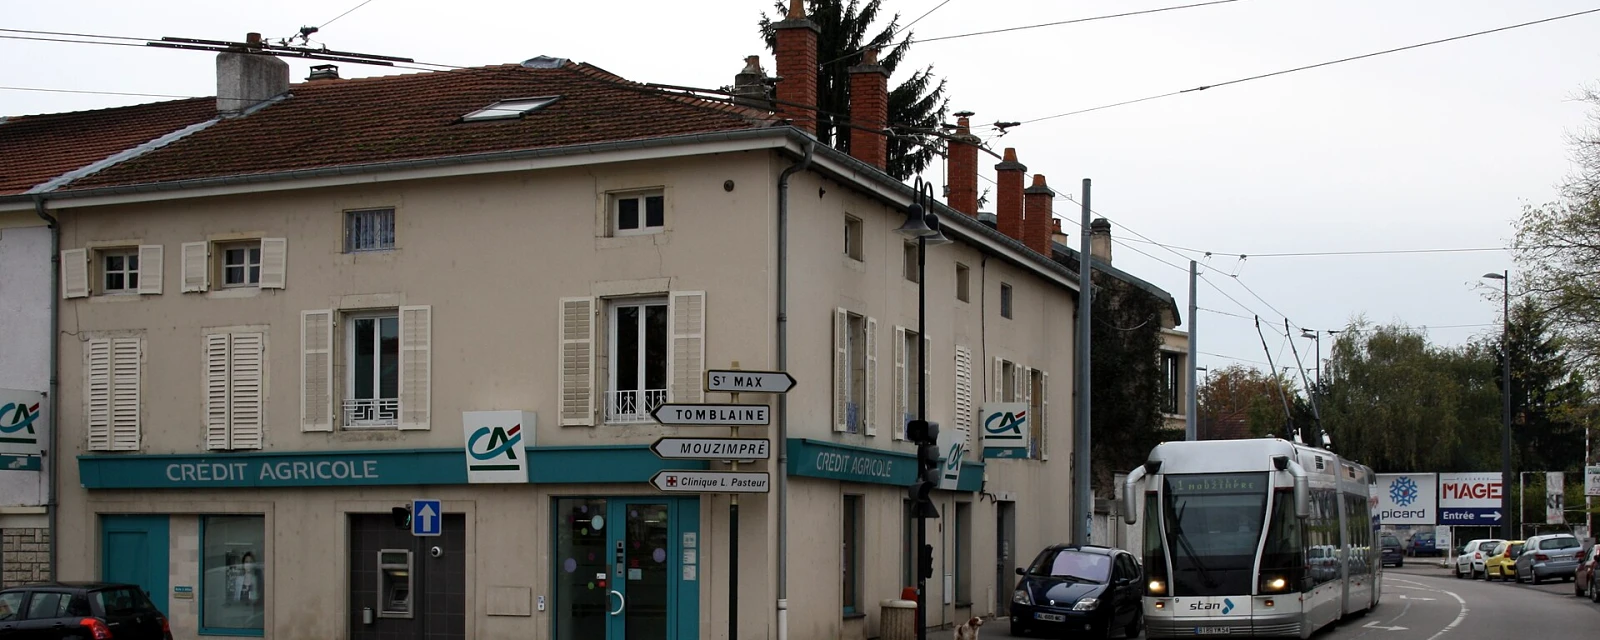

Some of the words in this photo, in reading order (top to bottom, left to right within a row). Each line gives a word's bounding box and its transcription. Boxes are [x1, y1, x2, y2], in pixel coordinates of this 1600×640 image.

[734, 376, 762, 388] MAX
[675, 409, 765, 421] TOMBLAINE
[680, 441, 766, 455] MOUZIMPRÉ
[816, 450, 850, 473] CRÉDIT
[850, 456, 893, 477] AGRICOLE
[166, 459, 248, 481] CRÉDIT
[259, 460, 379, 481] AGRICOLE
[681, 477, 718, 488] Clinique
[720, 478, 728, 487] L.
[730, 478, 766, 487] Pasteur
[1442, 483, 1503, 499] MAGE
[1381, 509, 1425, 520] picard
[1443, 511, 1475, 520] Entrée
[1189, 600, 1221, 611] stan
